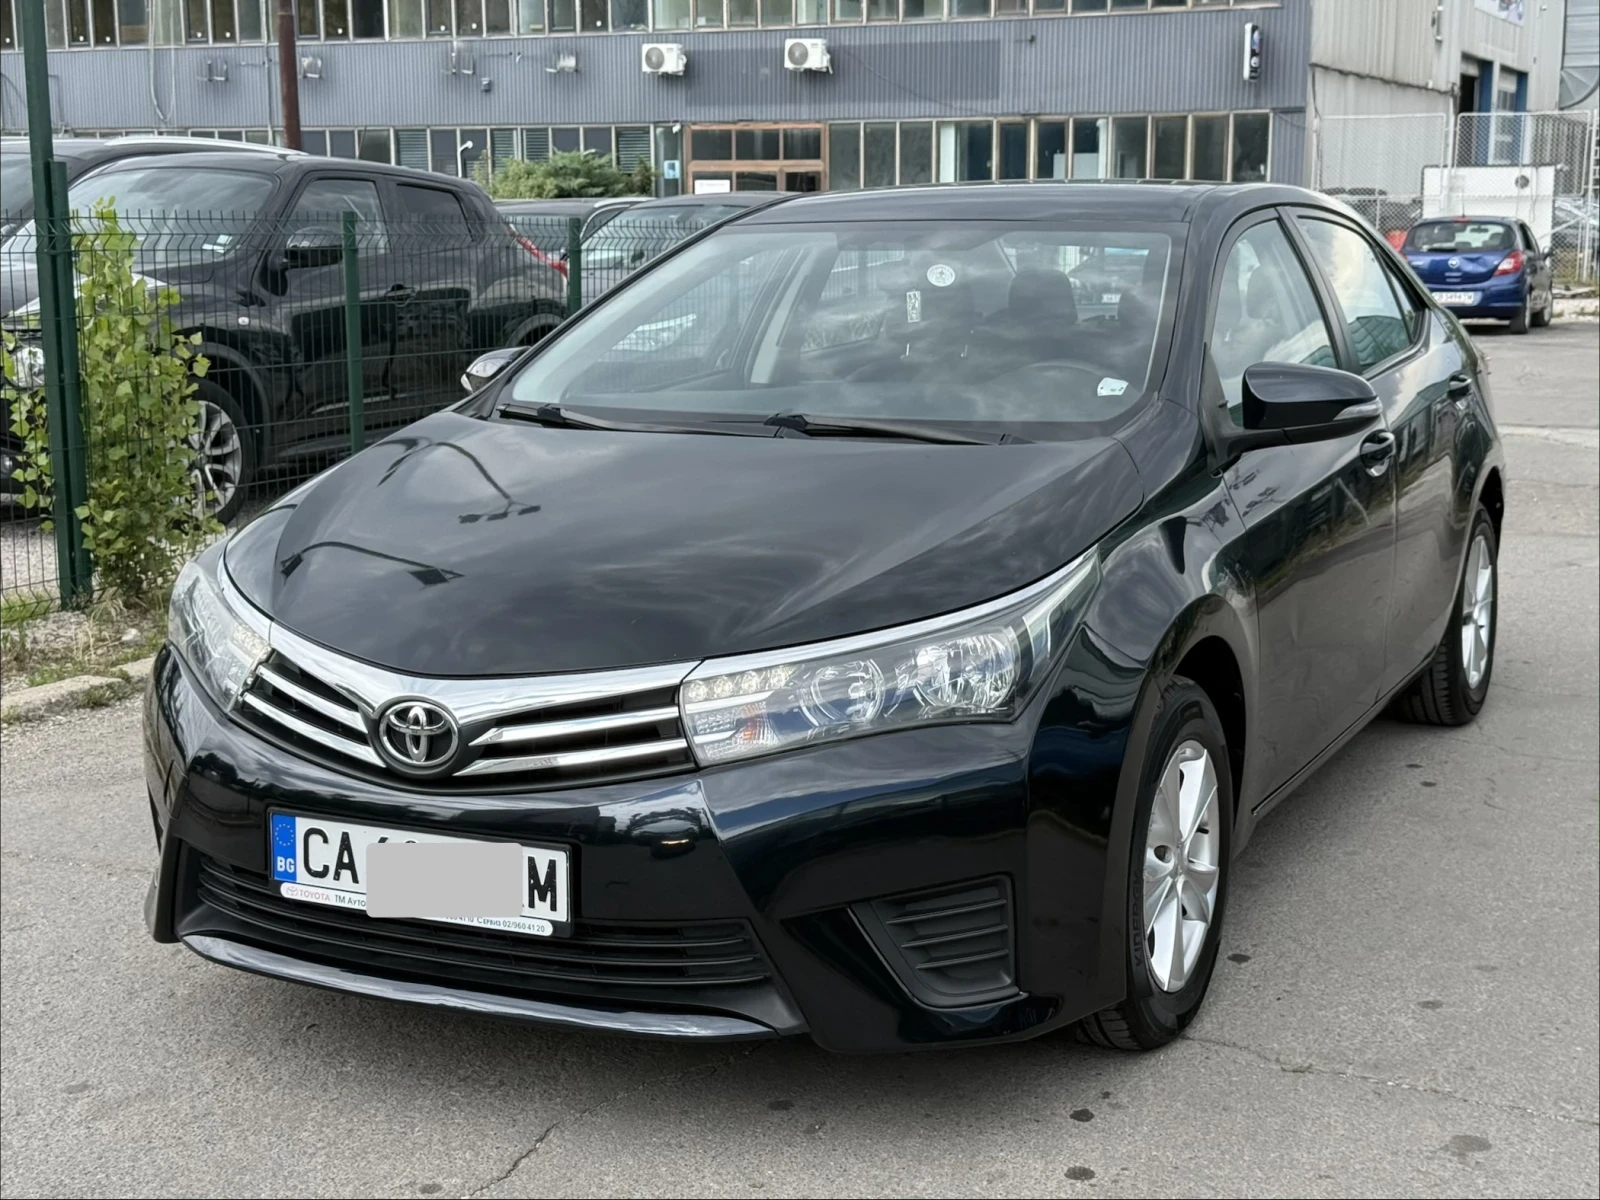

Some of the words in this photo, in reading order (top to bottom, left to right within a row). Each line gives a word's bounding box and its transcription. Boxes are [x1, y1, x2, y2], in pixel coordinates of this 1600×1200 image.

[277, 856, 295, 873] BG
[303, 827, 359, 884] CA
[522, 856, 557, 912] M
[299, 889, 330, 902] TOYOTA
